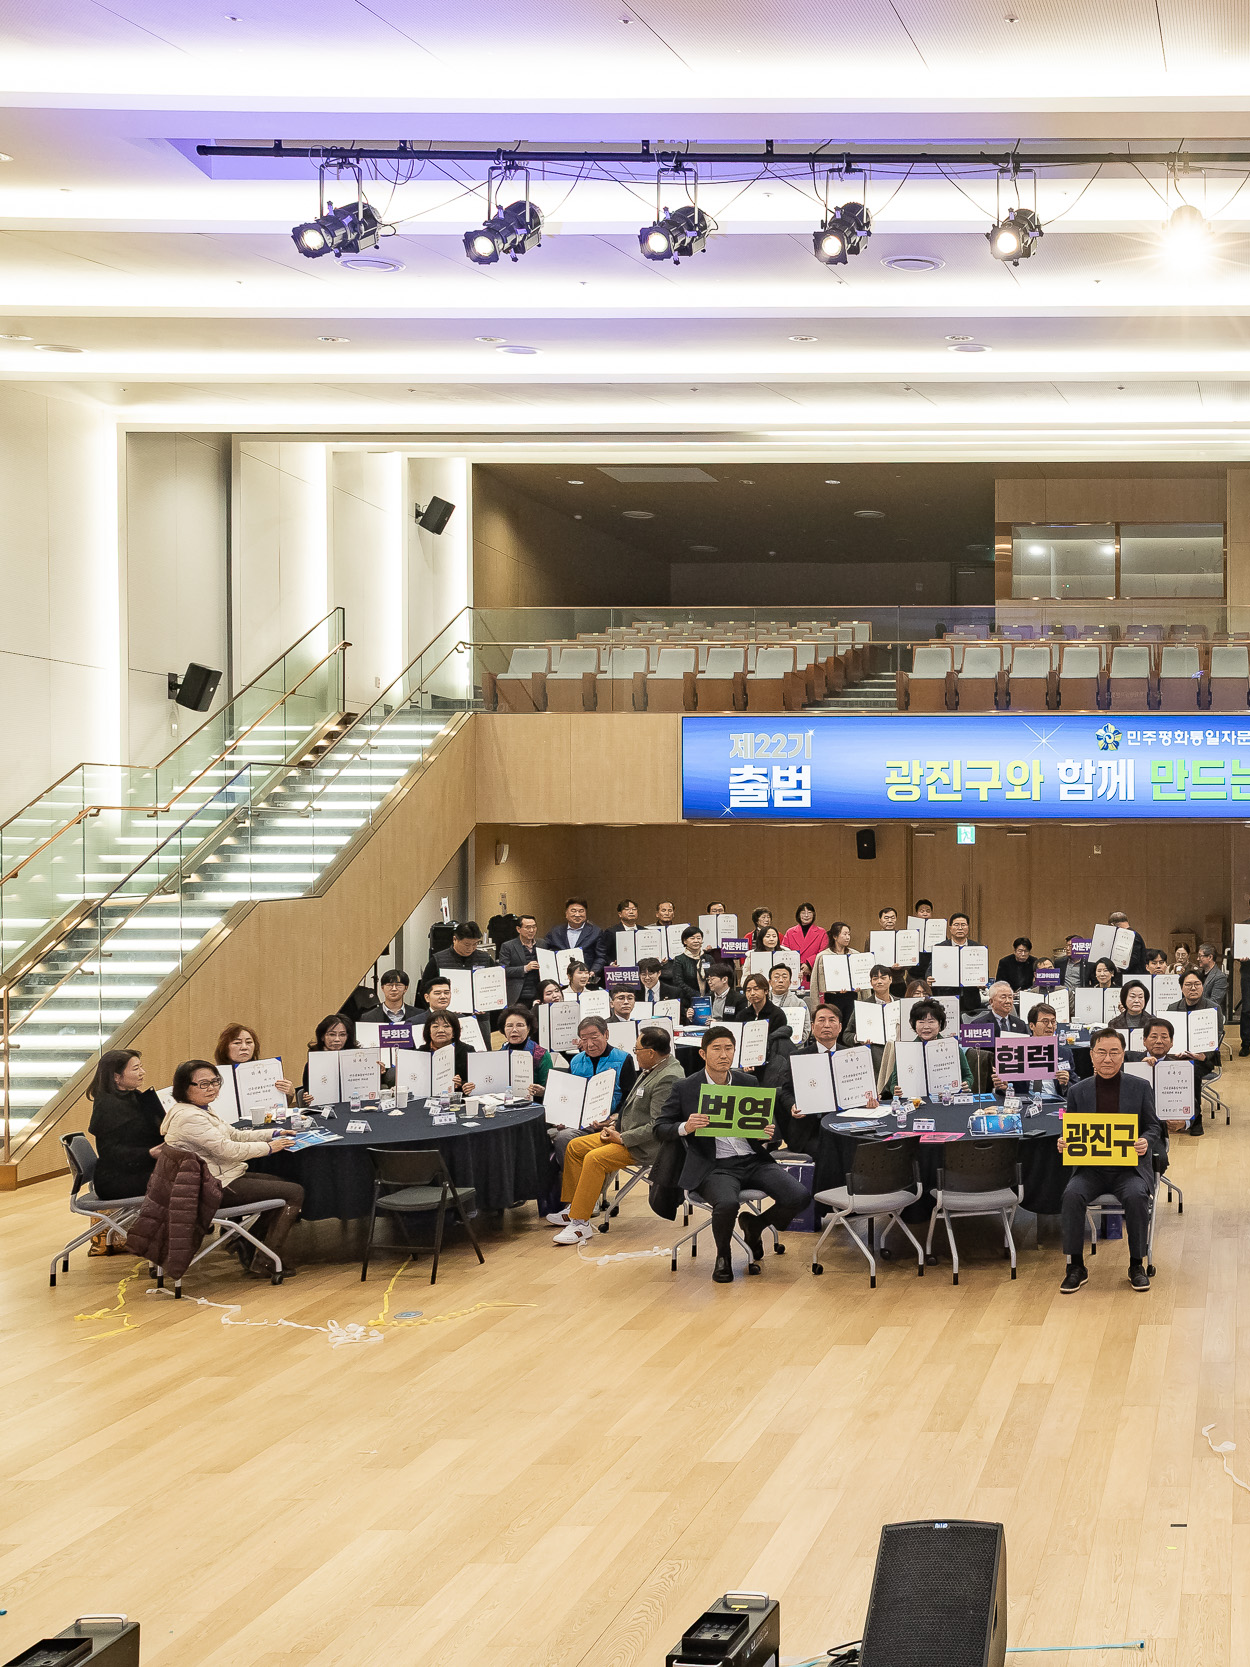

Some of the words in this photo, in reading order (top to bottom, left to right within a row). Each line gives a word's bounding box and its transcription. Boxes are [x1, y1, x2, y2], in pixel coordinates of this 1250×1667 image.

[729, 732, 812, 760] 제22기
[728, 764, 812, 808] 출범
[885, 759, 1045, 802] 광진구와
[1056, 758, 1136, 802] 함께
[721, 941, 750, 951] 자문위원
[1072, 941, 1092, 951] 자문위
[605, 971, 640, 981] 자문위원
[381, 1028, 411, 1039] 부회장
[963, 1028, 992, 1038] 내빈석
[996, 1044, 1055, 1075] 협력
[700, 1094, 772, 1130] 번영
[1065, 1122, 1136, 1158] 광진구
